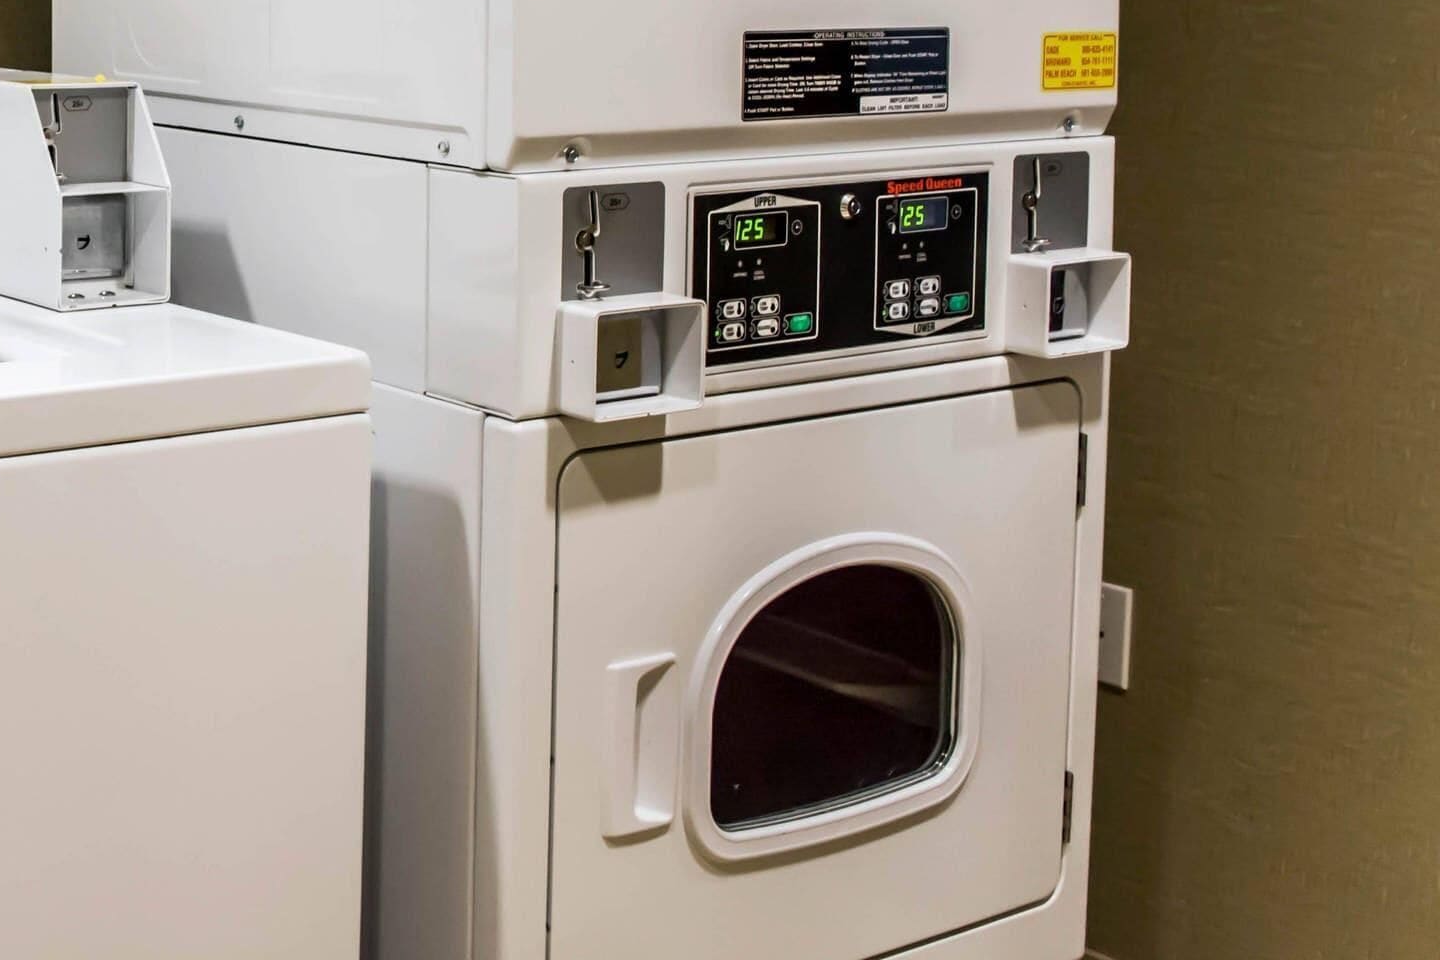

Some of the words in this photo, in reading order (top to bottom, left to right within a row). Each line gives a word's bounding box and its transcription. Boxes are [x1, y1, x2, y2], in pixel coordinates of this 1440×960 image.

[888, 179, 924, 195] Speed
[926, 177, 961, 189] Queen
[754, 196, 776, 207] UPPER
[736, 218, 763, 241] 125
[914, 322, 935, 334] LOWER
